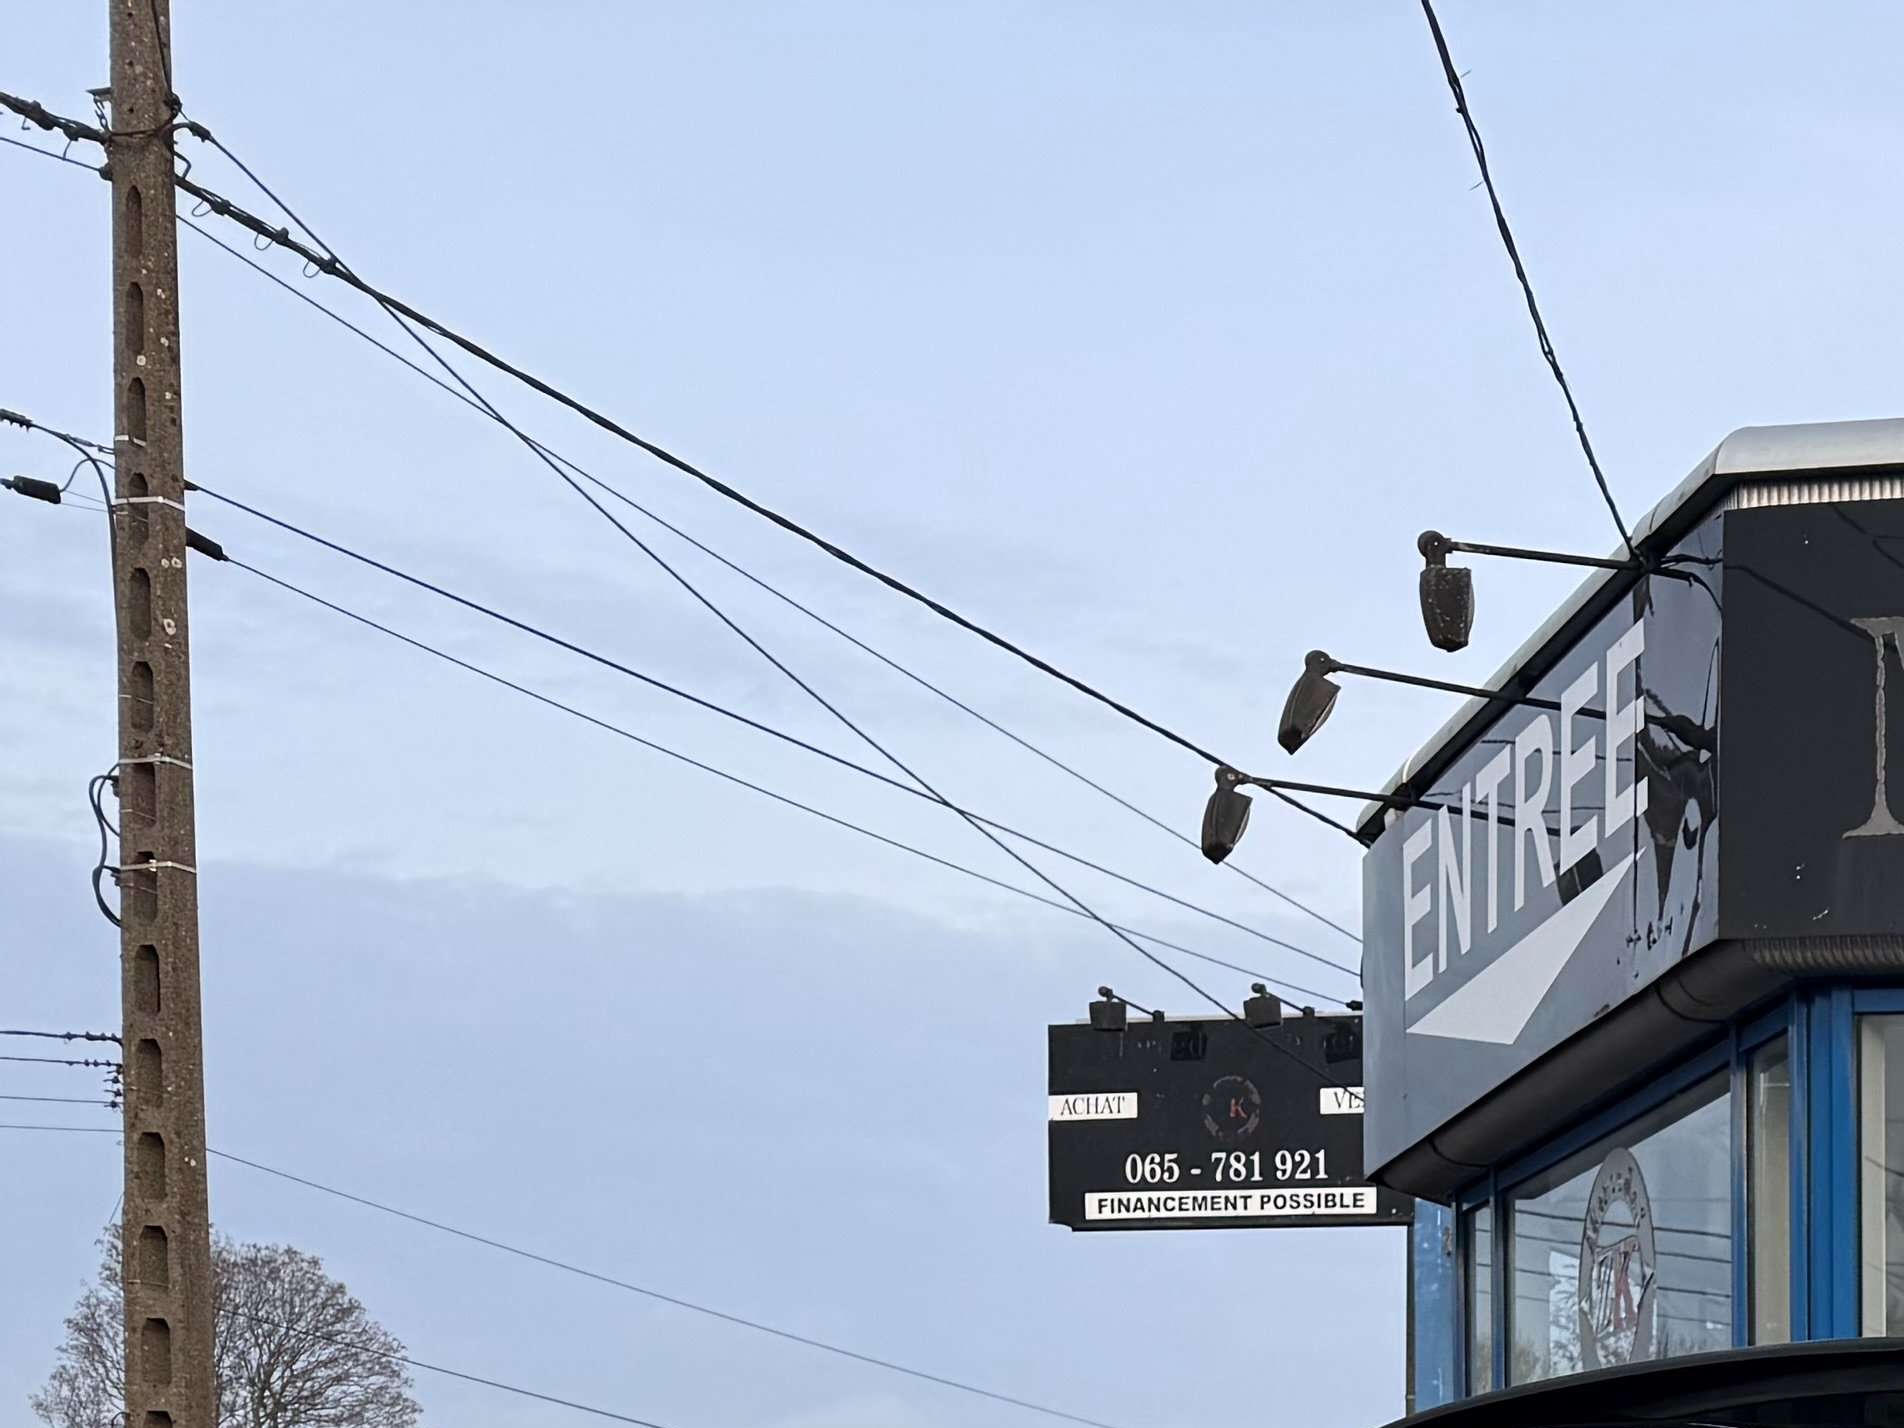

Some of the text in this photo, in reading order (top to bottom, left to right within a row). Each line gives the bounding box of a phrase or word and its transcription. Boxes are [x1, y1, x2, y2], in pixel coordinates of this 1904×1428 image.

[1402, 616, 1649, 1002] ENTREE
[1060, 1095, 1126, 1117] ACHAT
[1125, 1153, 1180, 1184] 065
[1211, 1151, 1264, 1183] 781
[1274, 1149, 1329, 1181] 921
[1097, 1192, 1366, 1215] FINANCEMENT POSSIBLE
